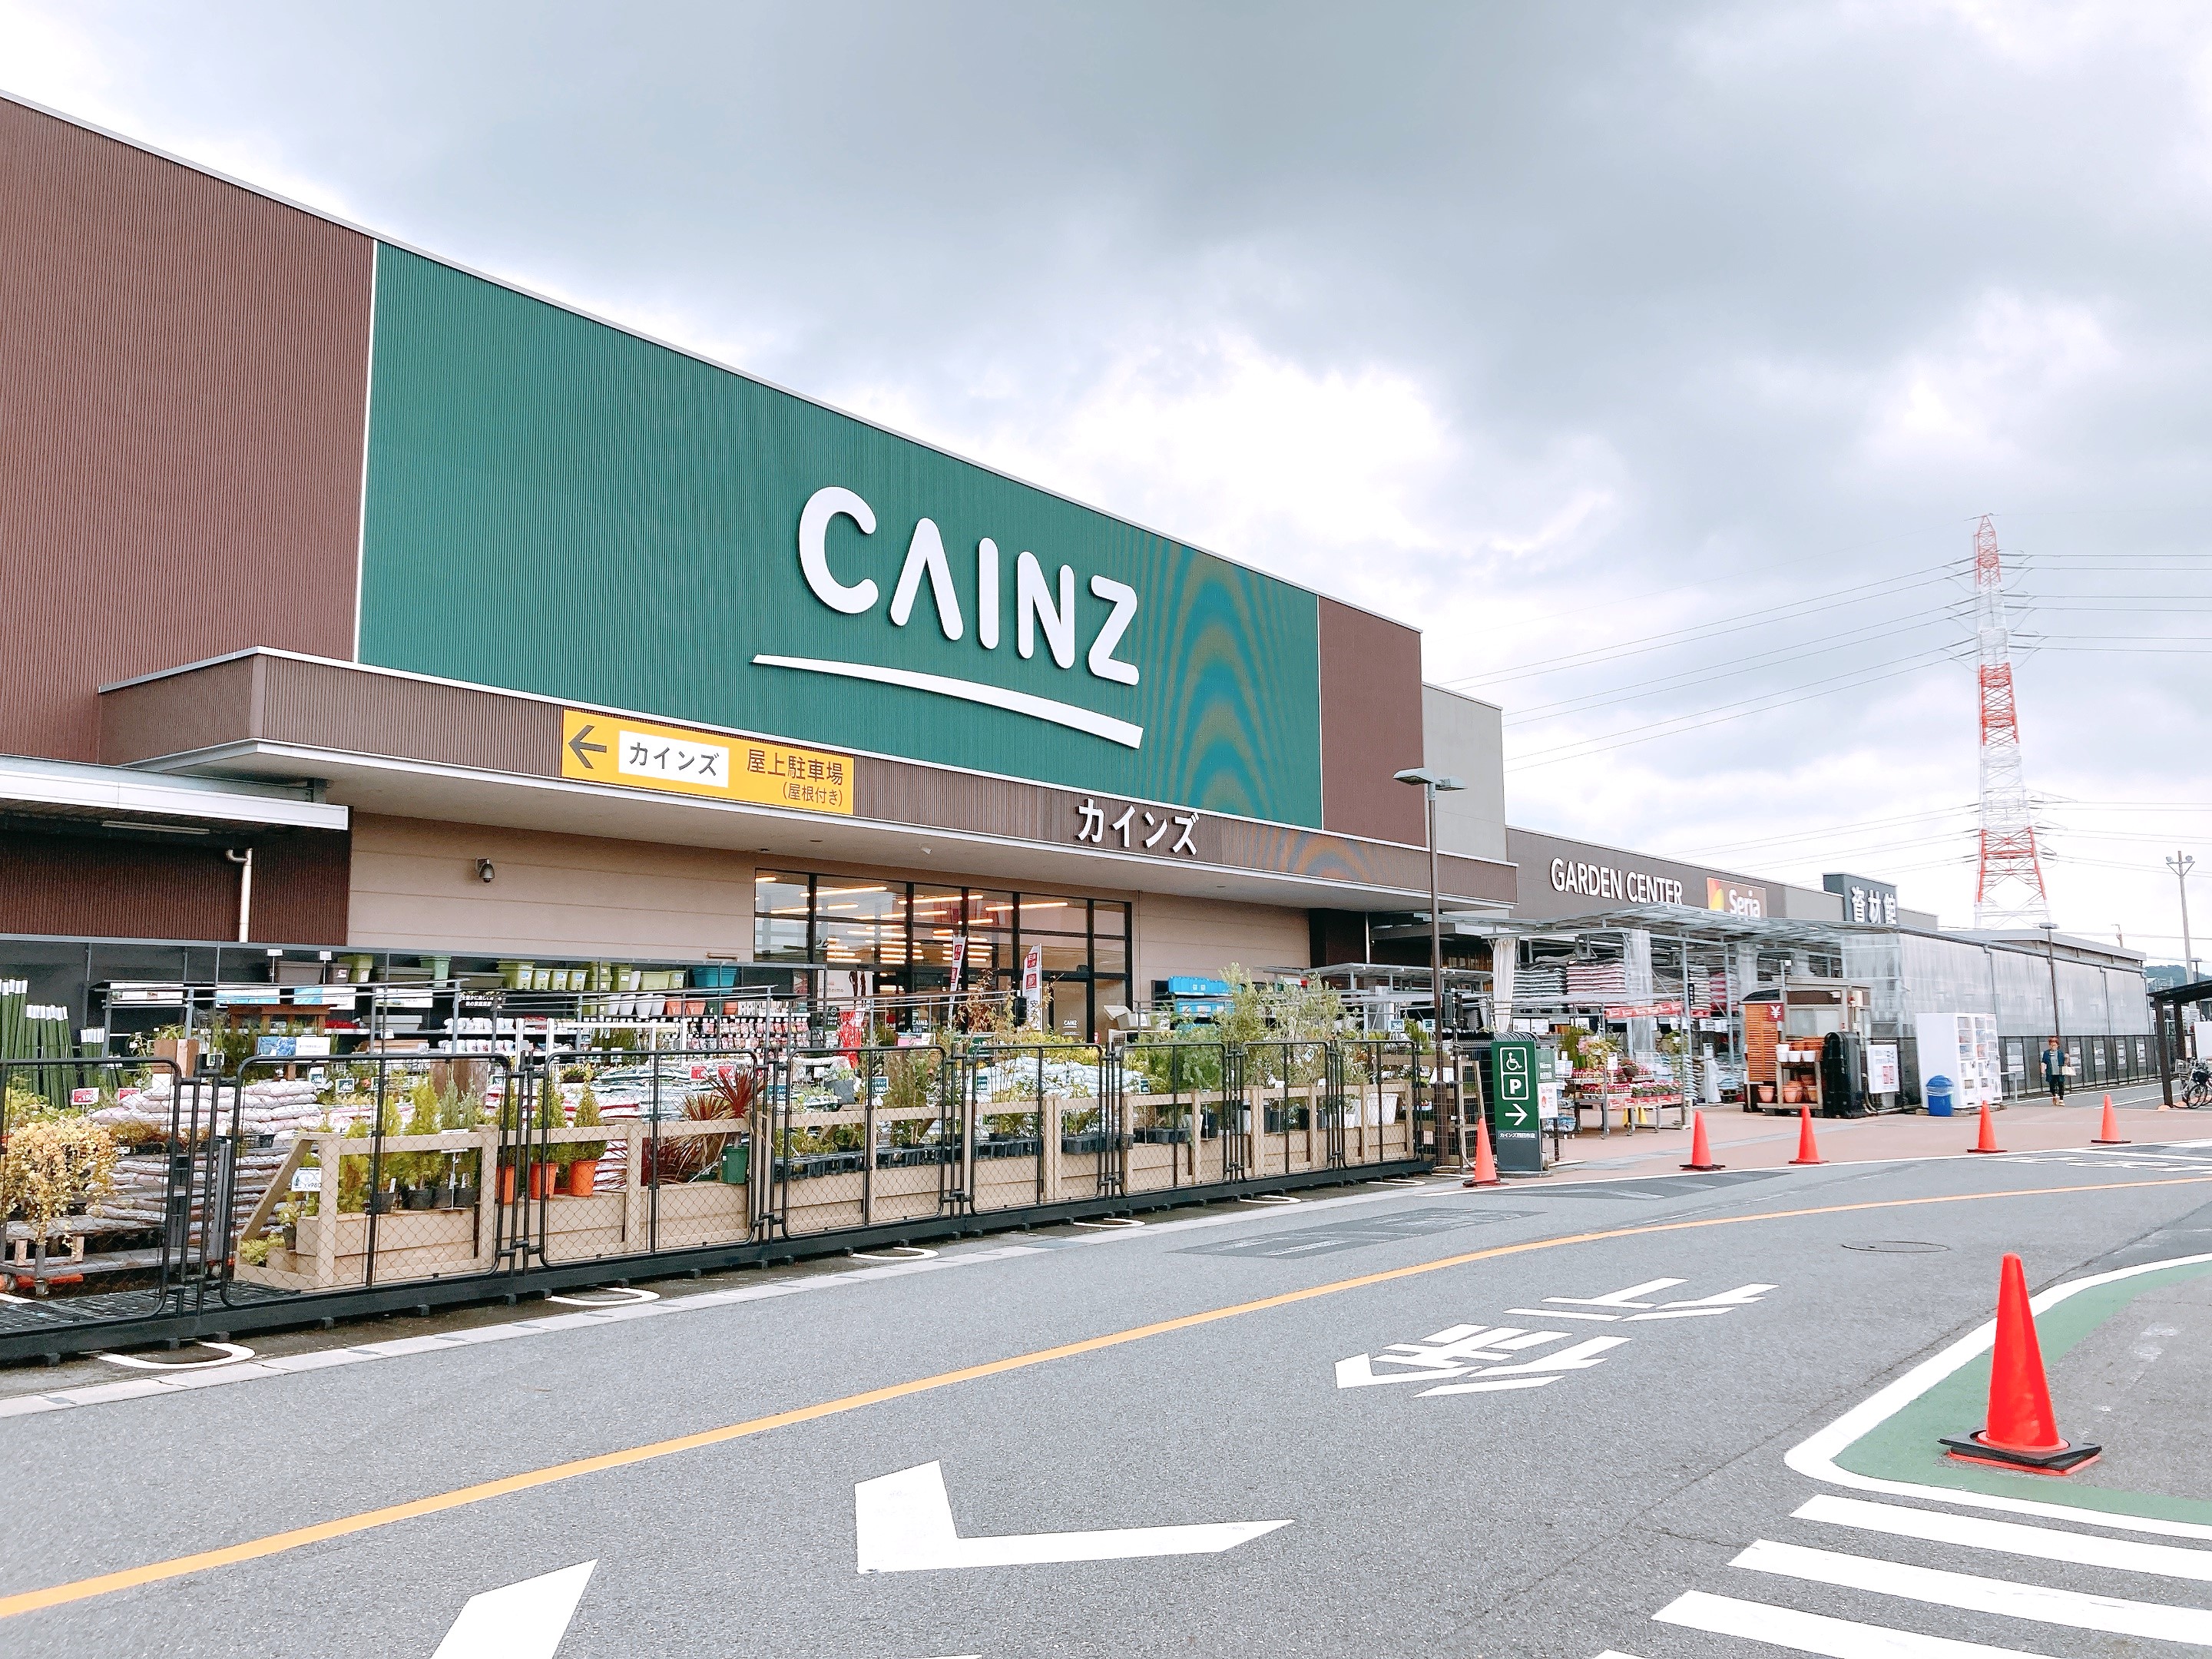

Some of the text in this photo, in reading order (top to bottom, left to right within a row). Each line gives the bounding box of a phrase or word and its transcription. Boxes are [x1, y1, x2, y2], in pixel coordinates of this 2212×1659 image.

[799, 485, 1140, 686] CAINZ
[629, 741, 720, 777] カインズ
[747, 748, 844, 786] 屋上駐車場
[782, 780, 843, 807] (屋根付き)
[1078, 797, 1200, 856] カインズ
[1551, 857, 1684, 905] GARDEN CENTER
[1728, 888, 1761, 919] Seria
[1851, 886, 1897, 924] 資材館
[1509, 1078, 1522, 1094] P
